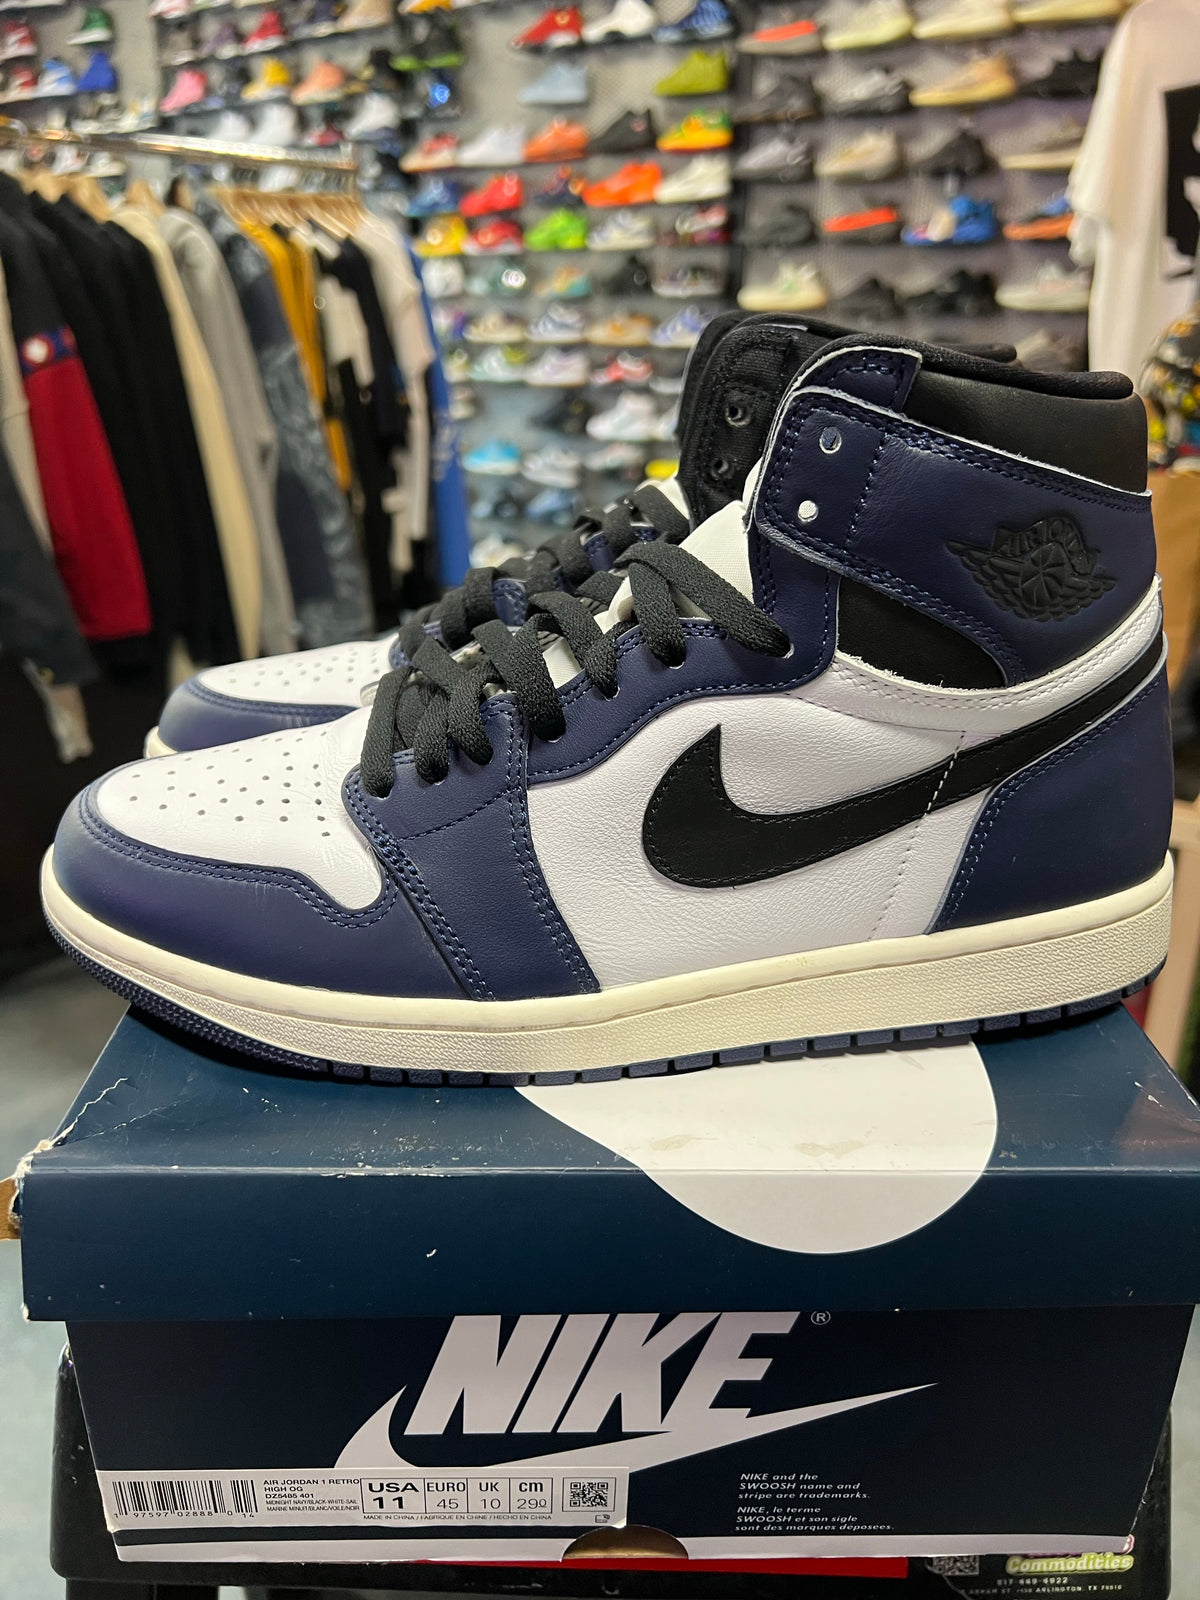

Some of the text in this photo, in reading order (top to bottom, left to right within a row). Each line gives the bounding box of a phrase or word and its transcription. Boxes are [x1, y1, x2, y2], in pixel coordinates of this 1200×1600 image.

[403, 1311, 800, 1436] NIKE
[368, 1482, 419, 1493] USA
[426, 1482, 466, 1493] EURO
[479, 1481, 499, 1492] UK
[518, 1482, 544, 1493] cm
[739, 1482, 796, 1490] SWOOSH
[837, 1482, 860, 1490] and
[738, 1492, 772, 1500] stripe
[799, 1491, 870, 1499] trademarks.
[372, 1496, 405, 1509] 11
[436, 1498, 459, 1510] 45
[480, 1498, 501, 1510] 10
[737, 1506, 769, 1514] NIKE,
[736, 1515, 792, 1523] SWOOSH
[831, 1515, 858, 1523] sigle
[1008, 1553, 1131, 1573] Commodities
